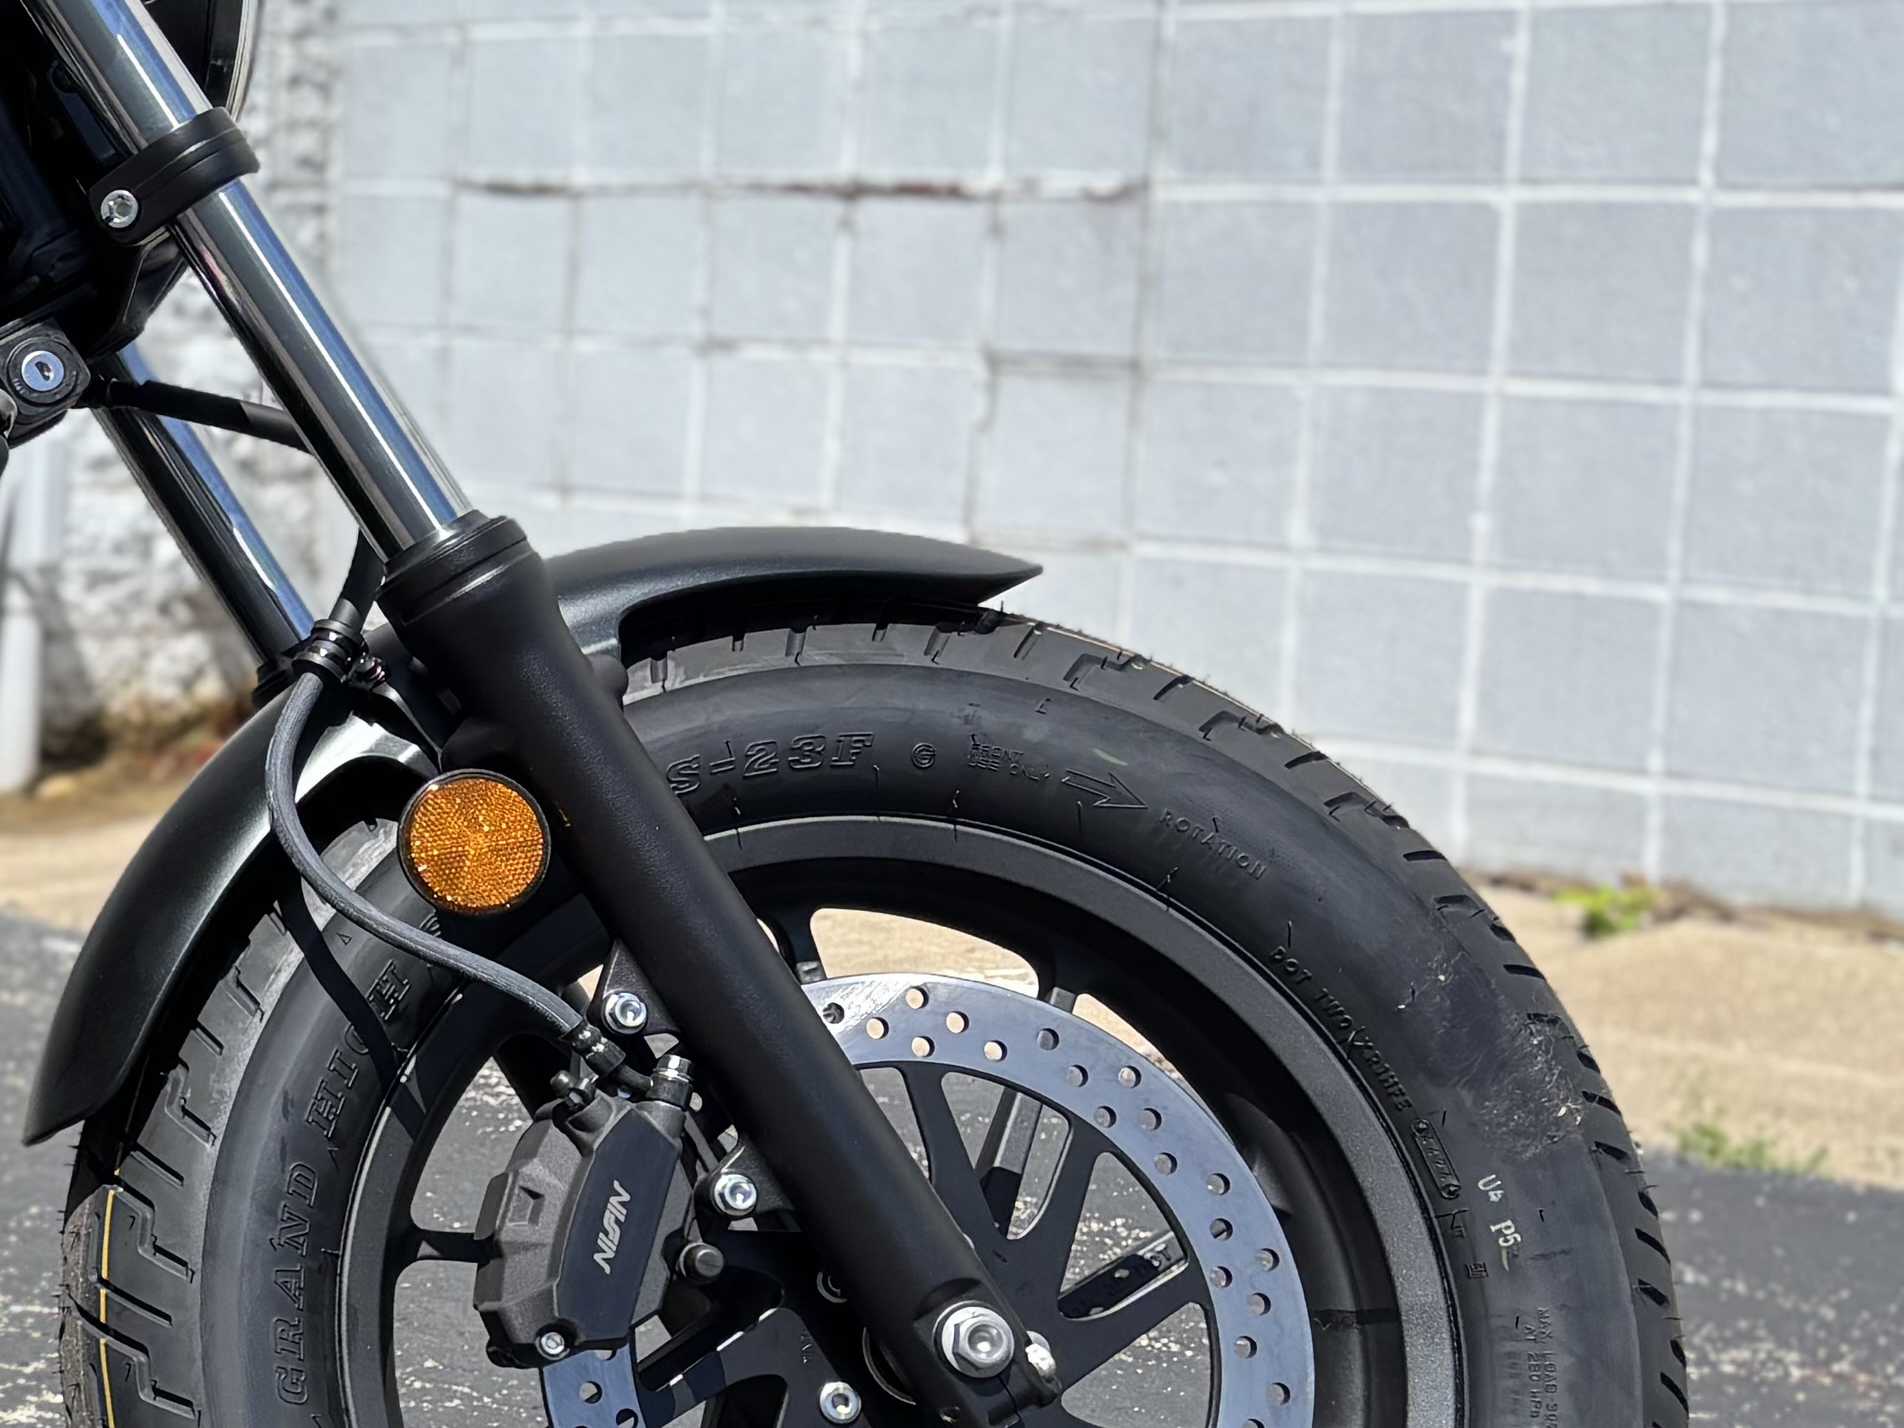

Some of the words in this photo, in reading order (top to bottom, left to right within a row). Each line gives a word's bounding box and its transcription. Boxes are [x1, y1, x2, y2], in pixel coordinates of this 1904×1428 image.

[666, 730, 874, 795] S-23F
[1158, 807, 1268, 880] ROTATION
[1269, 944, 1310, 986] DOT
[593, 1179, 631, 1275] NISSIN
[274, 1160, 320, 1406] GRAND
